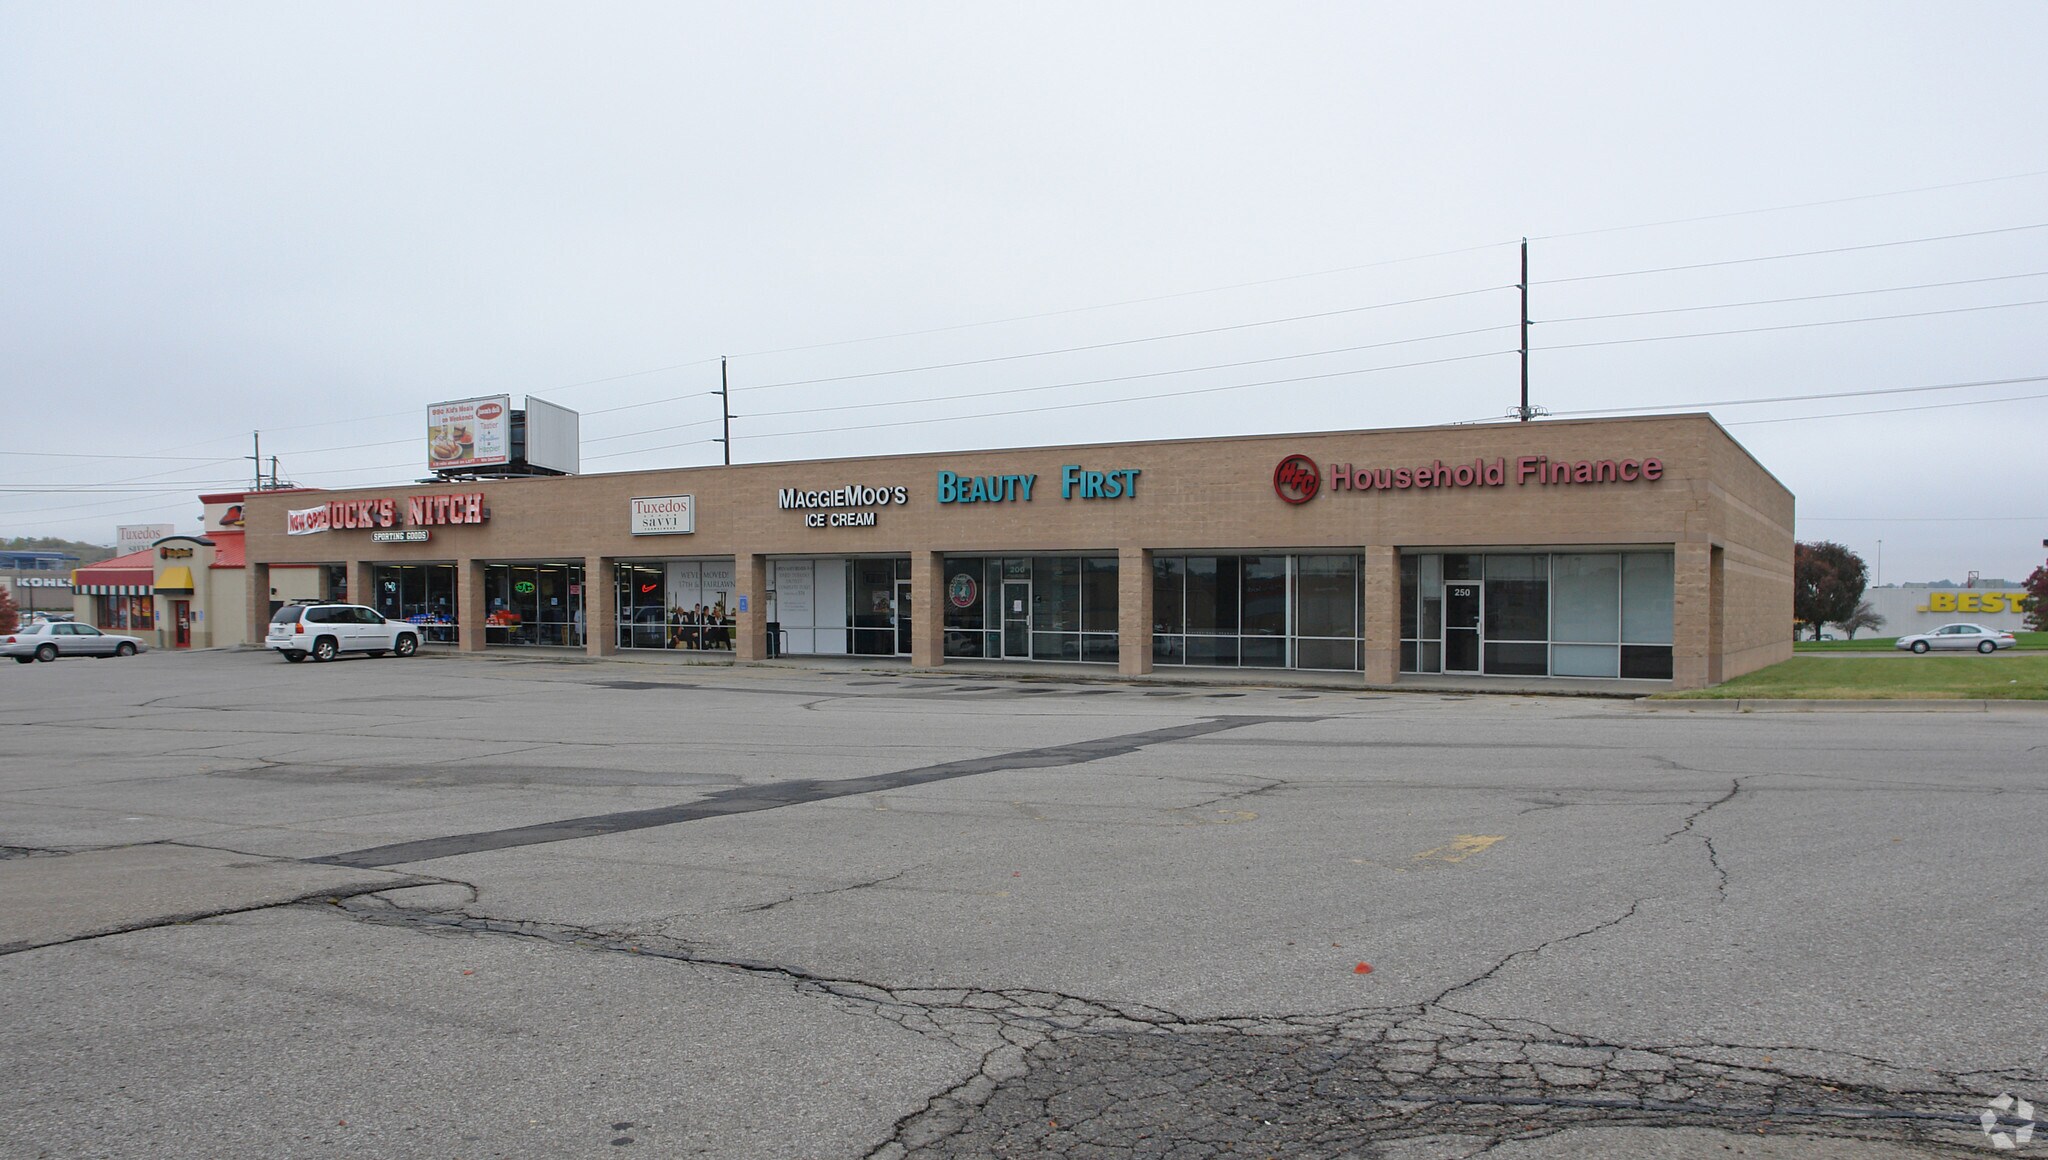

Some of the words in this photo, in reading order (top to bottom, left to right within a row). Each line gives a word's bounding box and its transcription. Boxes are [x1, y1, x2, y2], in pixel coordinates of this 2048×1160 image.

[1278, 460, 1316, 497] HFC
[1330, 457, 1505, 491] Household
[1516, 455, 1664, 485] Finance
[937, 470, 1036, 504] BEAUTY
[1061, 464, 1140, 500] FIRST
[320, 497, 397, 530] JOCK'S
[407, 492, 485, 526] NITCH
[634, 499, 687, 514] Tuxedos
[805, 513, 826, 527] ICE
[830, 512, 875, 527] CREAM
[119, 526, 161, 540] Tuxedos
[373, 531, 404, 541] SPORTING
[406, 531, 427, 540] GOODS
[679, 580, 693, 588] 17TH
[703, 580, 736, 588] FAIRLAWN
[1454, 588, 1471, 597] 250
[1929, 591, 2030, 614] BEST
